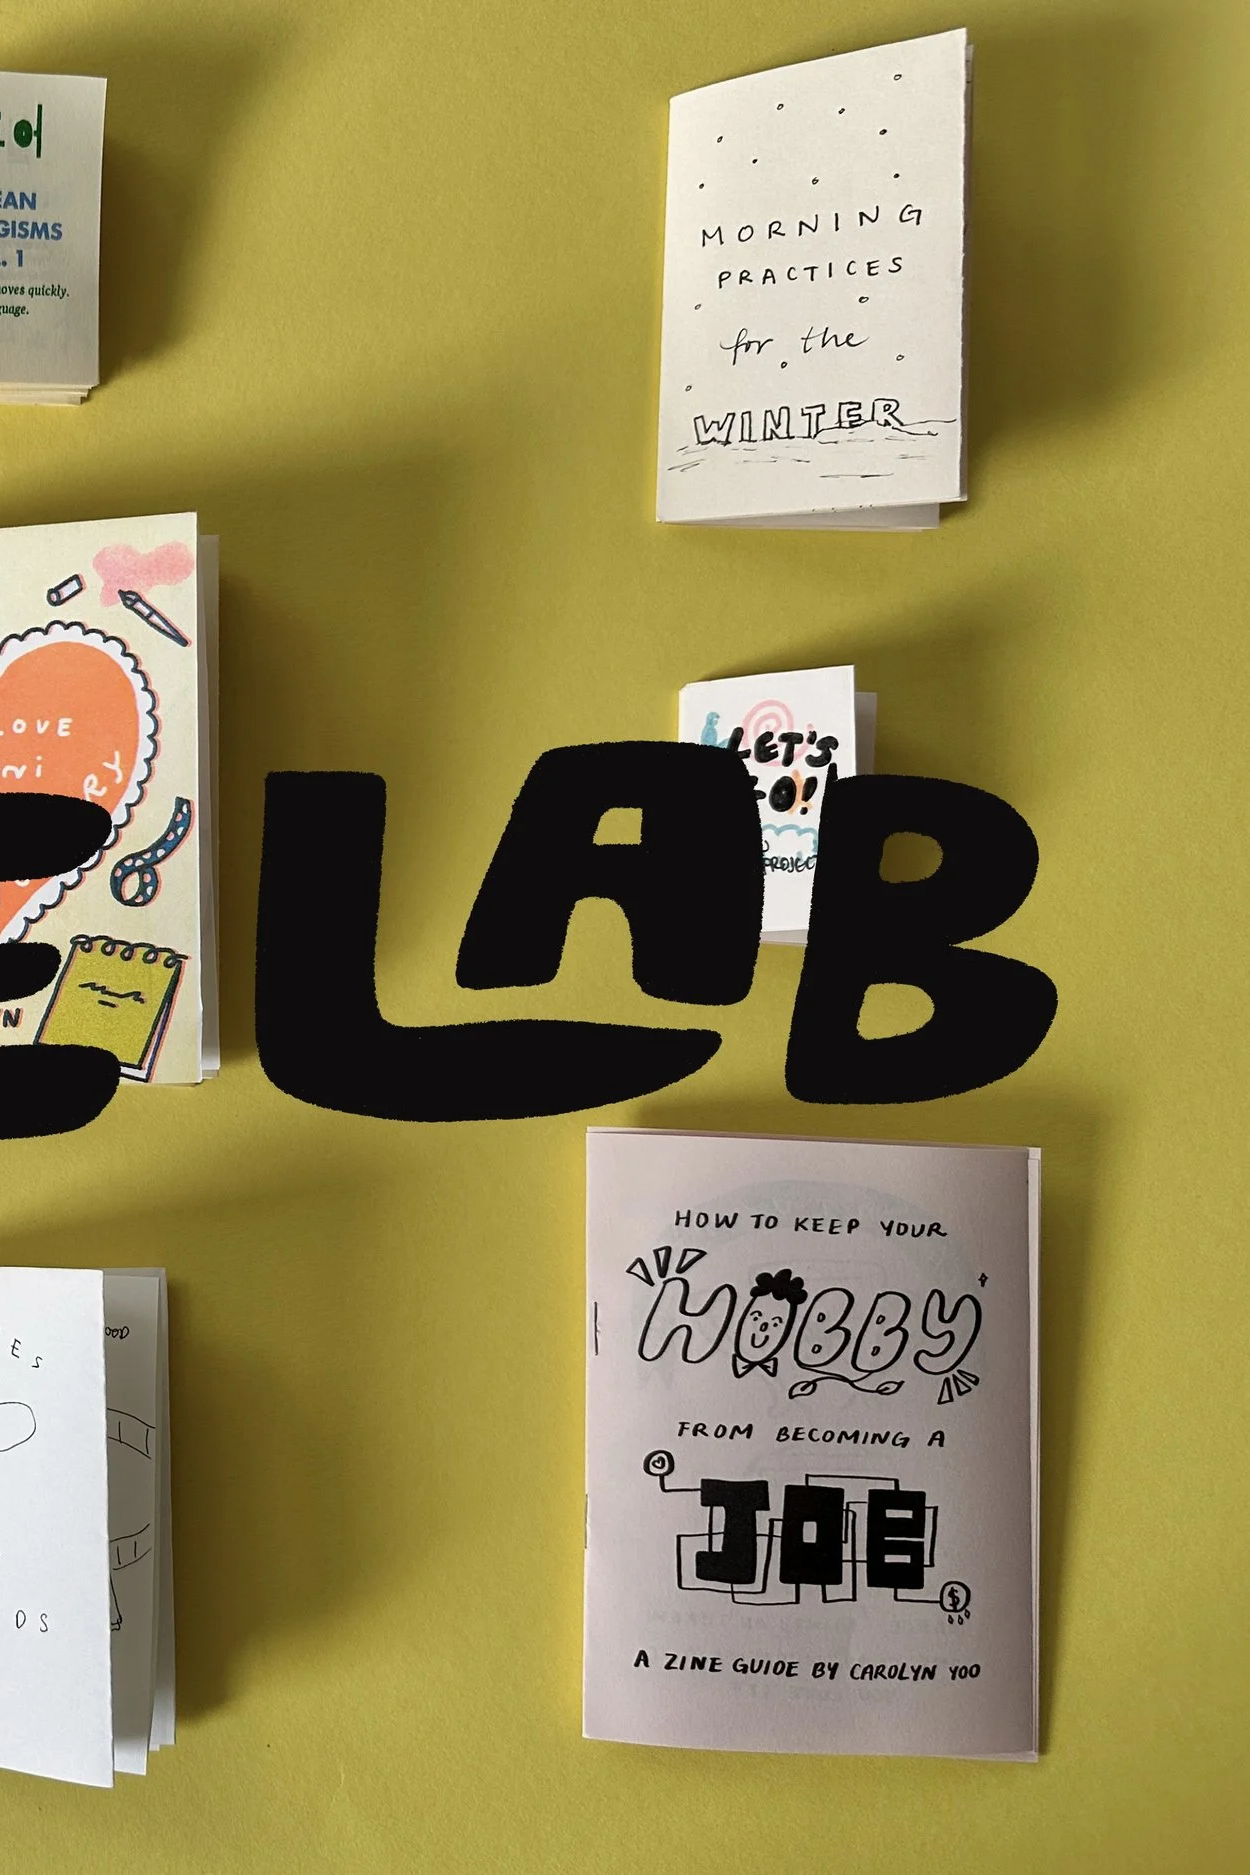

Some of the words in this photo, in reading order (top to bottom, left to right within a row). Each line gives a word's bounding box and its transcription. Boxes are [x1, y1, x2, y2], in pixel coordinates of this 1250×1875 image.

[701, 203, 922, 248] MORNING
[15, 249, 24, 267] 1
[718, 256, 904, 289] PRACTICES
[28, 284, 70, 299] quickly.
[720, 328, 775, 366] for
[801, 325, 870, 353] the
[693, 398, 903, 445] WINTER
[727, 727, 839, 767] LET'S
[750, 775, 818, 815] O!
[675, 1210, 738, 1229] HOW
[751, 1214, 778, 1230] TO
[794, 1217, 860, 1235] KEEP
[880, 1220, 948, 1237] YOUR
[637, 1270, 982, 1376] HOBBY
[678, 1421, 754, 1441] FROM
[776, 1425, 910, 1449] BECOMING
[927, 1430, 946, 1448] A
[633, 1650, 650, 1670] A
[664, 1653, 722, 1674] ZINE
[733, 1656, 799, 1678] GUIDE
[812, 1661, 839, 1681] BY
[849, 1661, 937, 1682] CAROLYN
[948, 1663, 981, 1681] YOO
